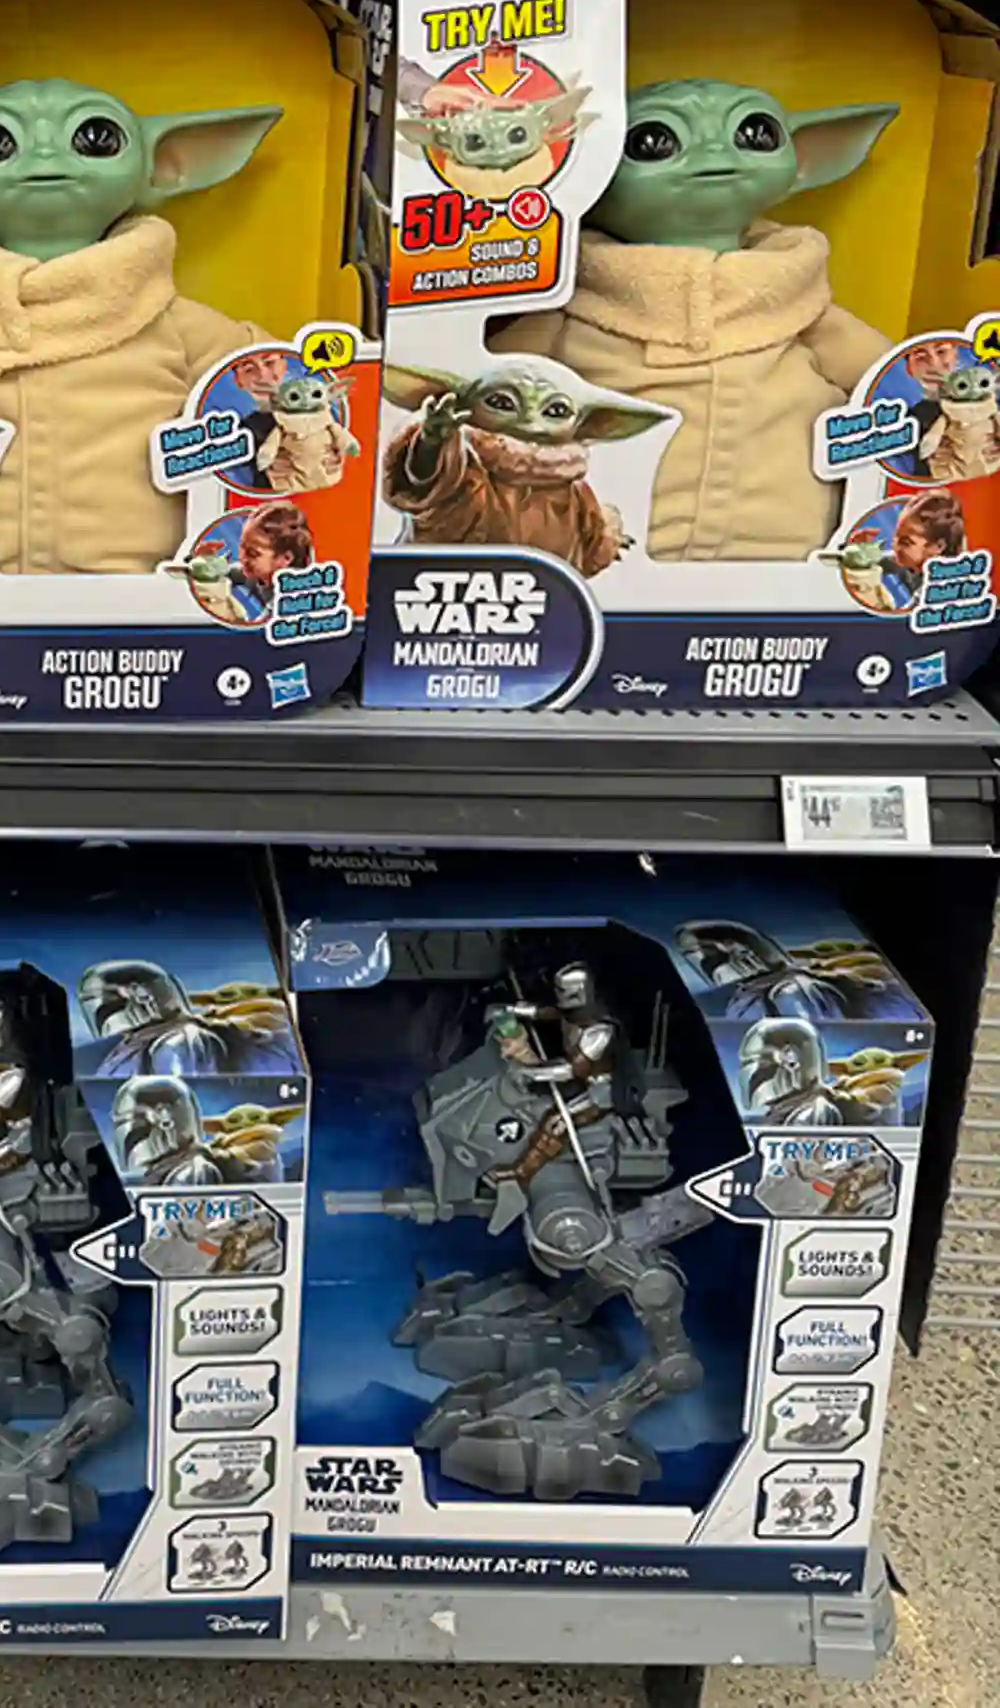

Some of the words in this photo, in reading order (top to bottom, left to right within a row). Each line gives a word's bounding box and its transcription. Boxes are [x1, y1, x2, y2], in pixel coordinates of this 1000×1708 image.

[422, 9, 496, 54] TRY
[401, 192, 493, 253] 50+
[41, 650, 114, 675] ACTION
[118, 650, 183, 674] BUDDY
[304, 1457, 403, 1477] STAR
[304, 1473, 403, 1494] WARS
